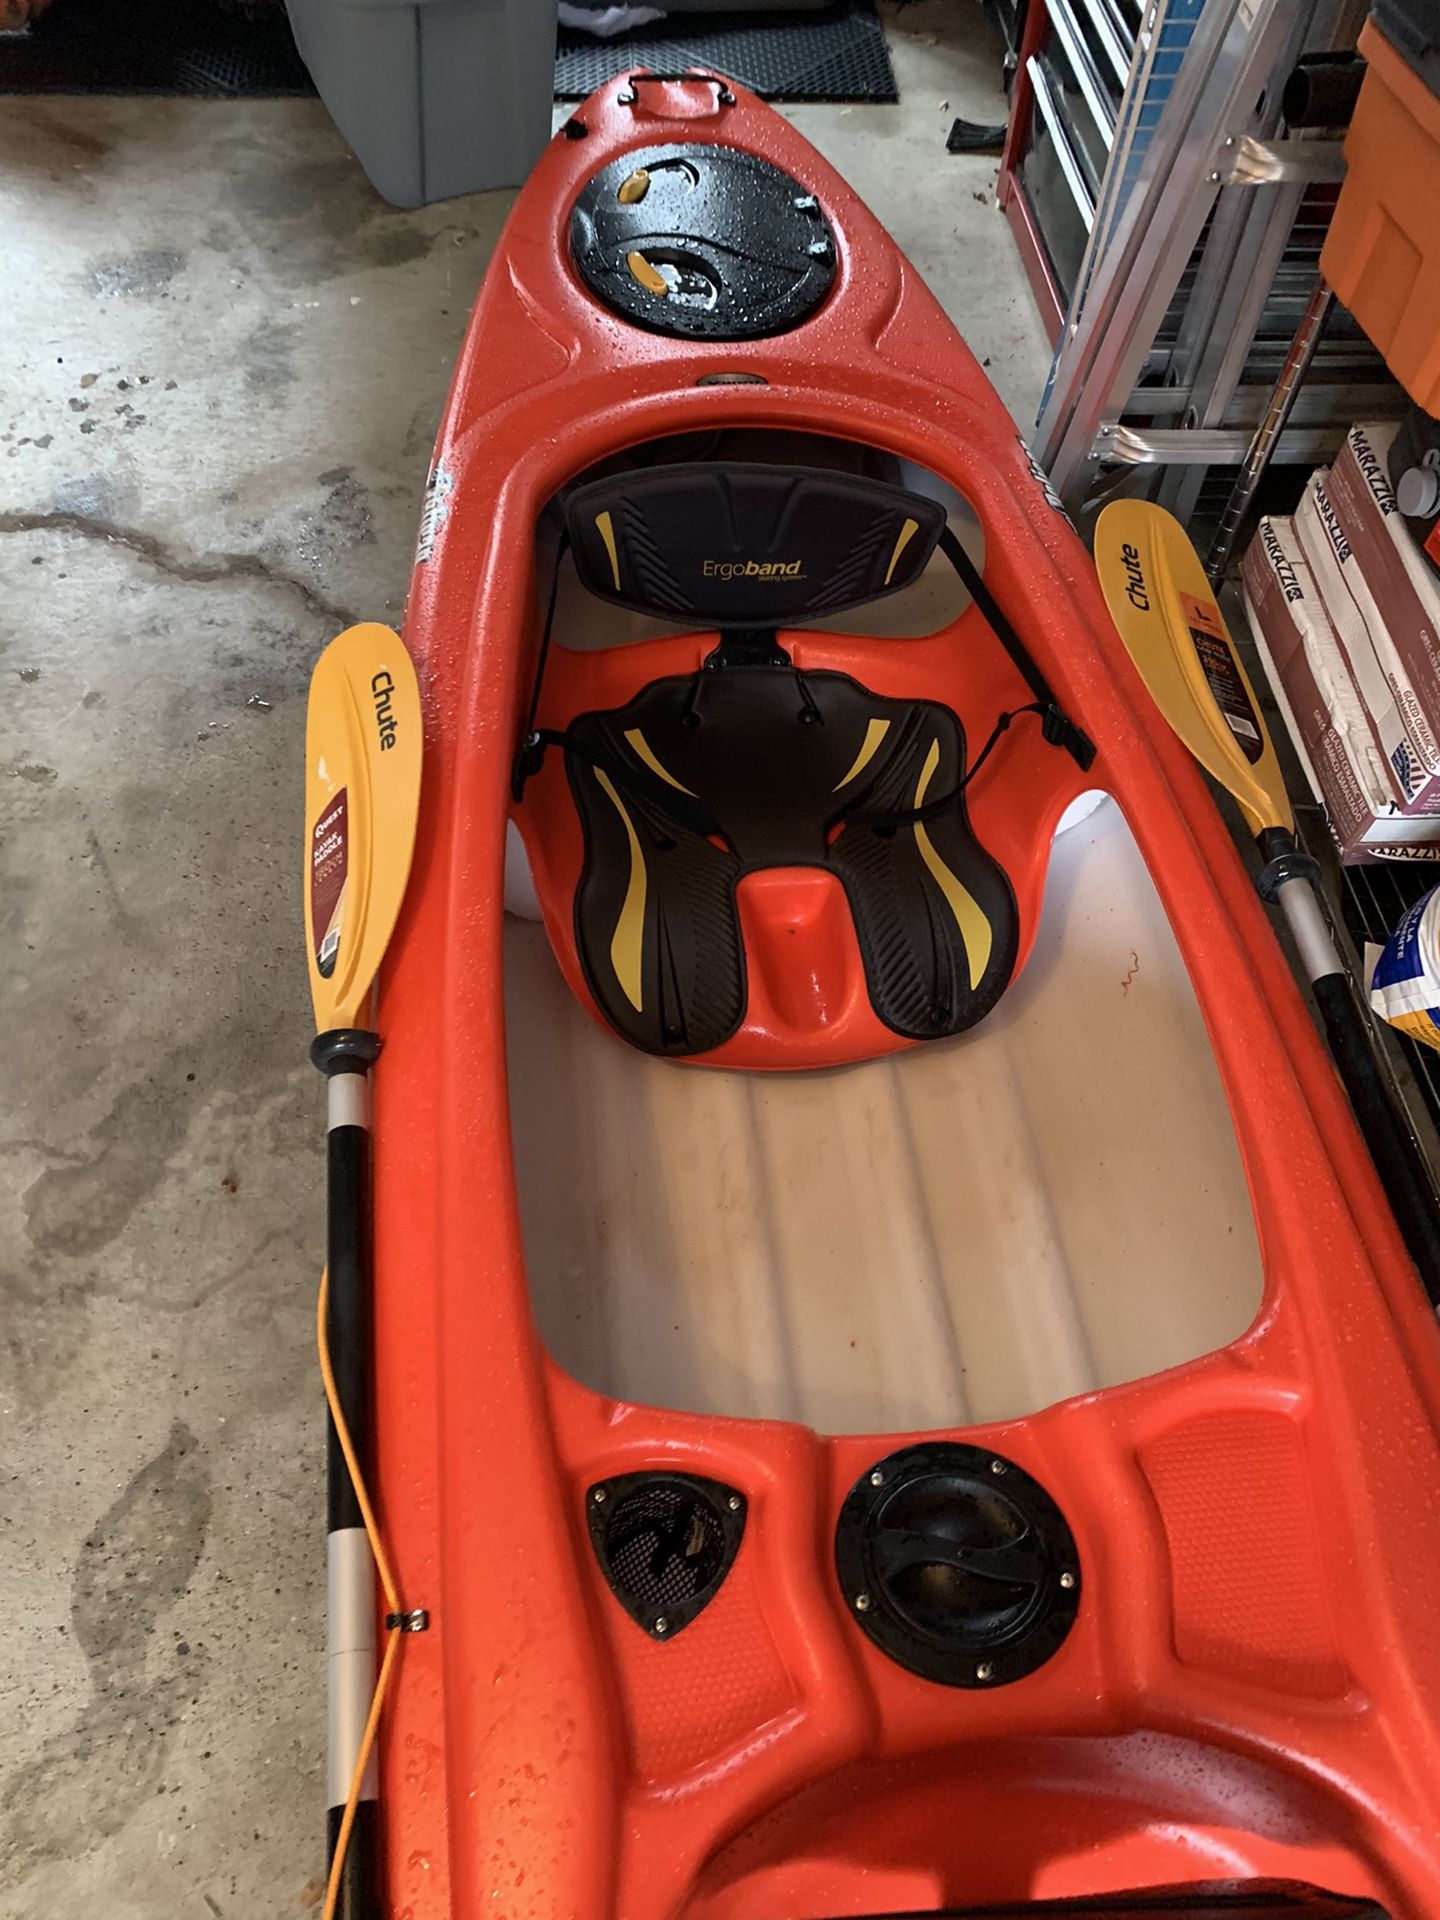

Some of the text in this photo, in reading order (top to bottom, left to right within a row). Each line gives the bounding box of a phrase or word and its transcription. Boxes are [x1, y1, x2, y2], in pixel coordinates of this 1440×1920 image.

[1350, 430, 1395, 502] MARAZZI
[703, 559, 802, 581] Ergoband
[1120, 543, 1150, 611] Chute
[371, 671, 398, 751] Chute
[1403, 690, 1421, 718] GLAZED
[1414, 717, 1434, 751] CERAMIC
[1328, 728, 1346, 761] GLAZED
[1341, 760, 1361, 799] CERAMIC
[1356, 796, 1369, 816] TILE
[1336, 771, 1362, 822] ESMALTADO
[1370, 847, 1437, 859] ARAZZI
